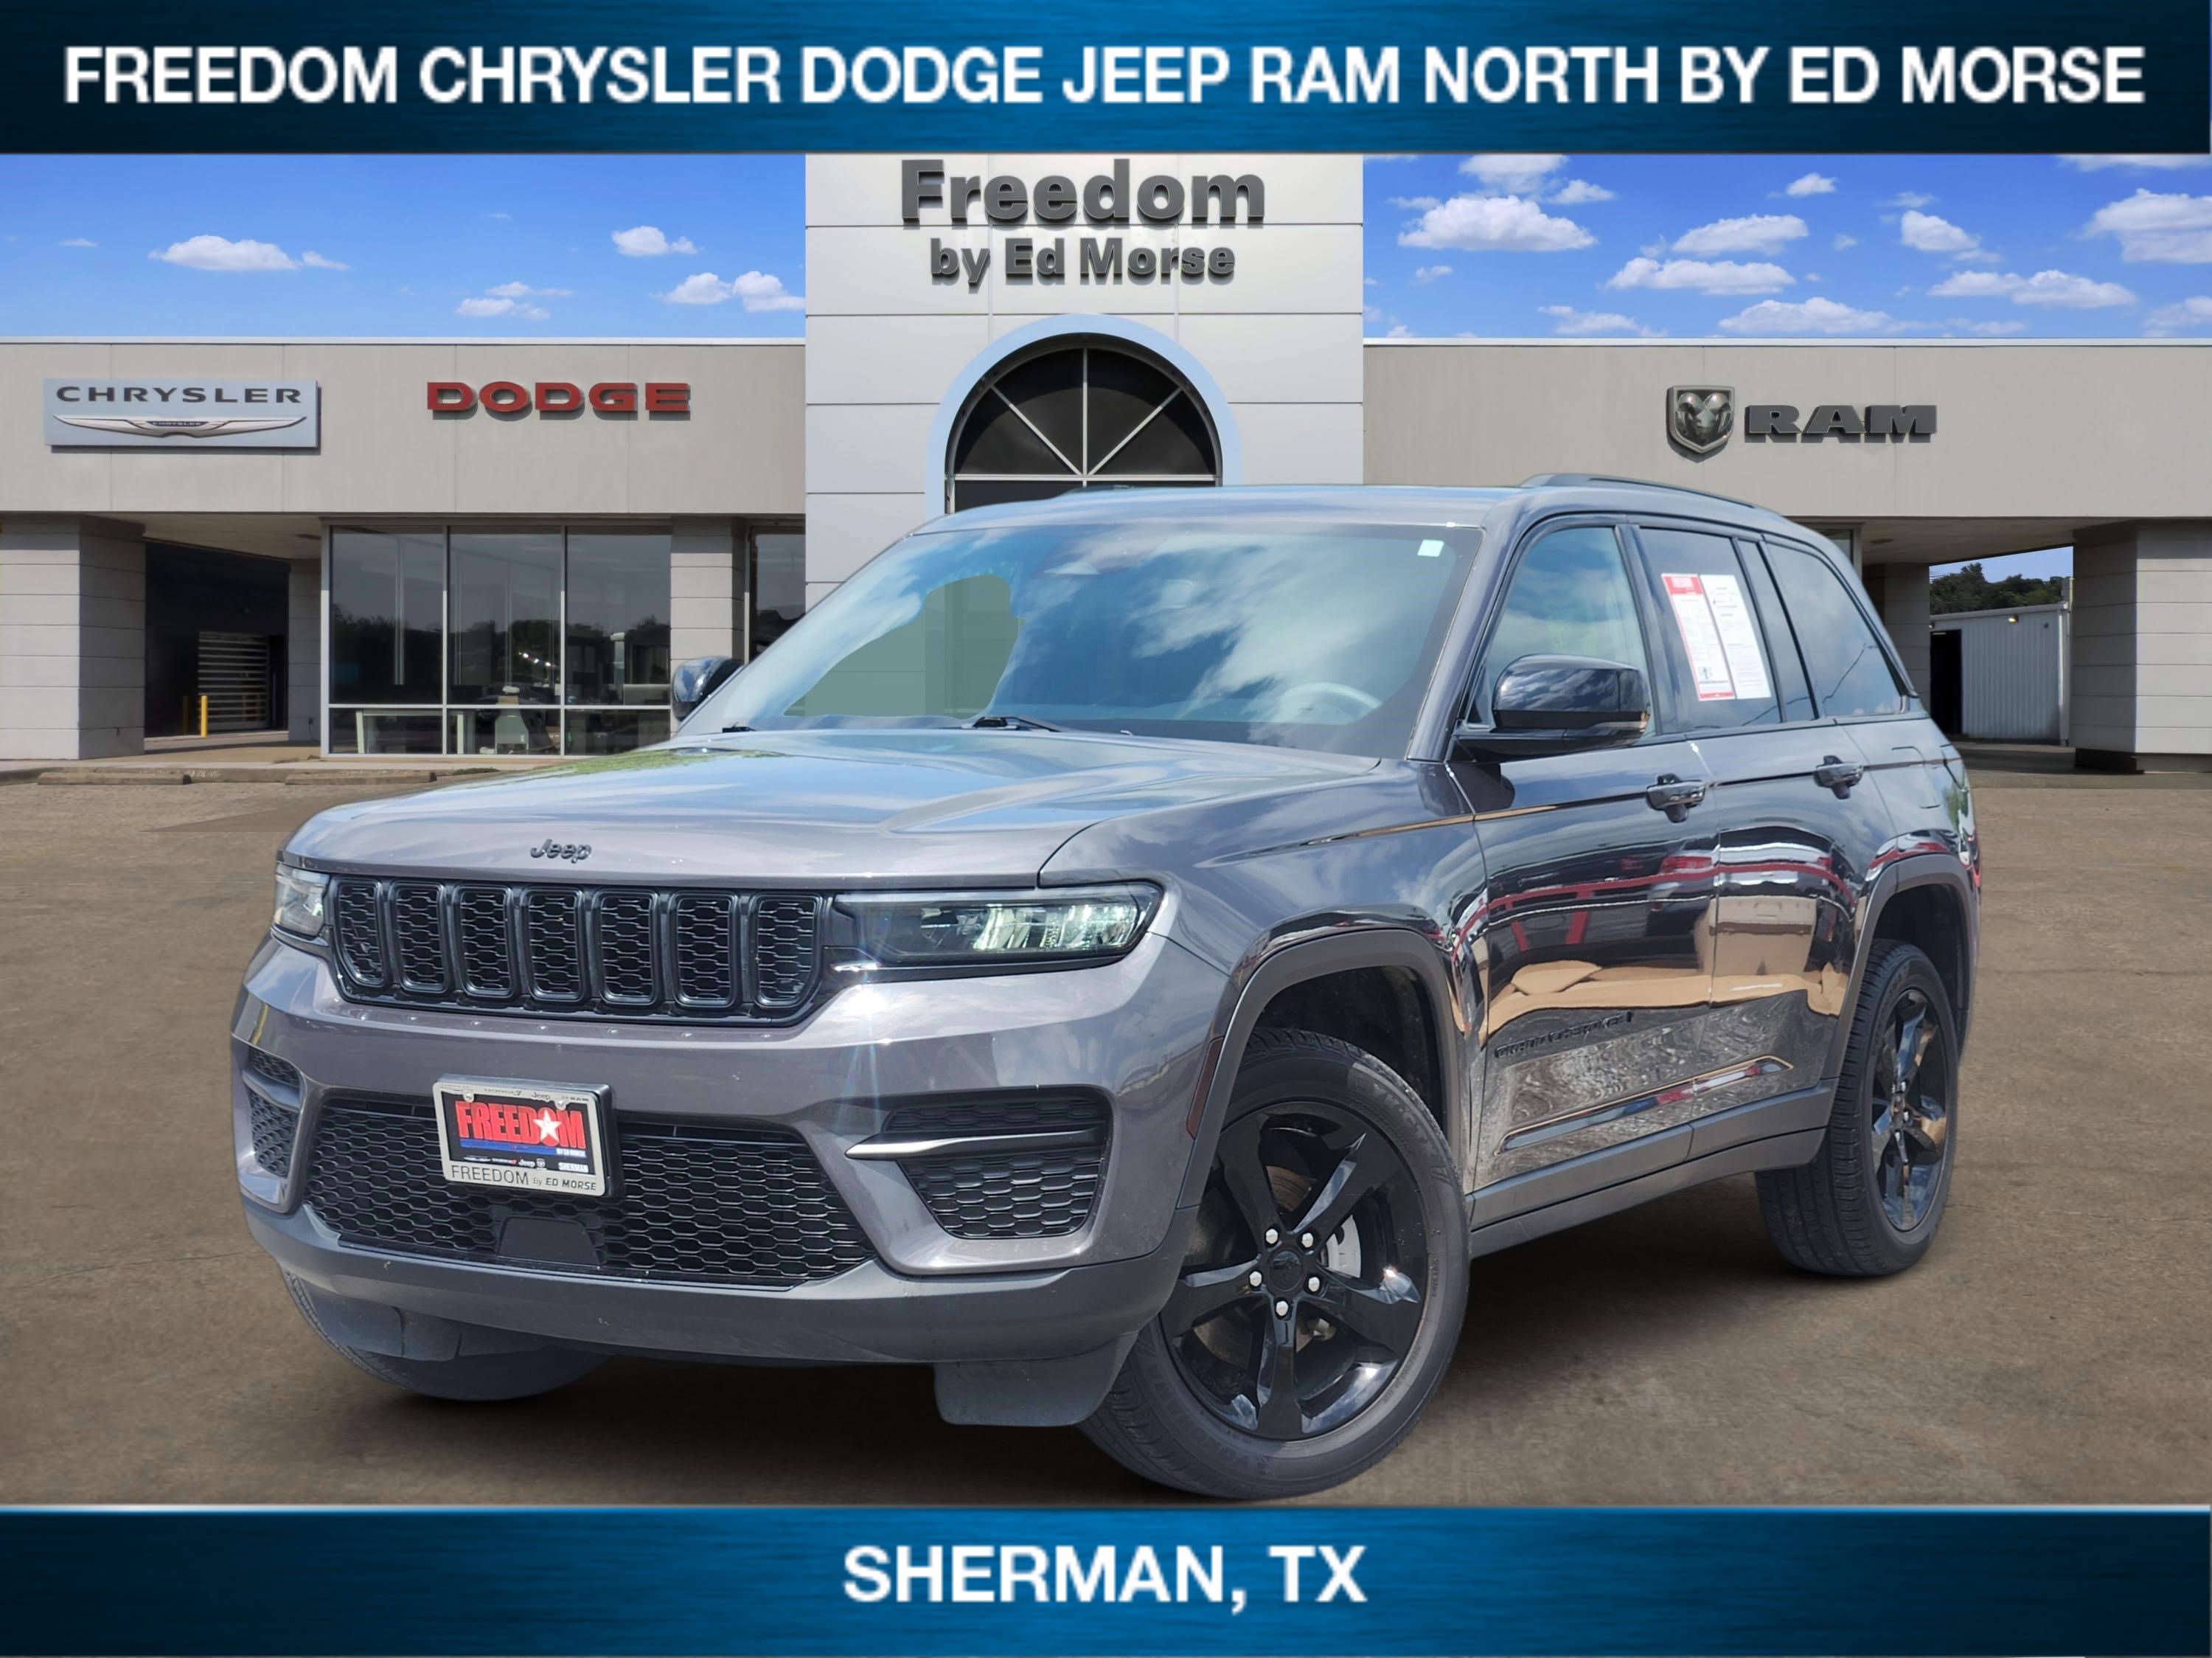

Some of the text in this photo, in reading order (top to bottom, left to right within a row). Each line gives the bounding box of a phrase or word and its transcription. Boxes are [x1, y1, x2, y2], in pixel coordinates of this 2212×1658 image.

[902, 159, 1265, 225] Freedom
[931, 237, 1235, 286] by Ed Morse
[56, 386, 301, 403] CHRYSLER
[427, 381, 690, 412] DODGE
[1745, 404, 1937, 434] RAM
[530, 838, 592, 864] Jeep
[455, 1100, 587, 1150] FREEDOM
[451, 1165, 597, 1190] FREEDOM By ED MORSE
